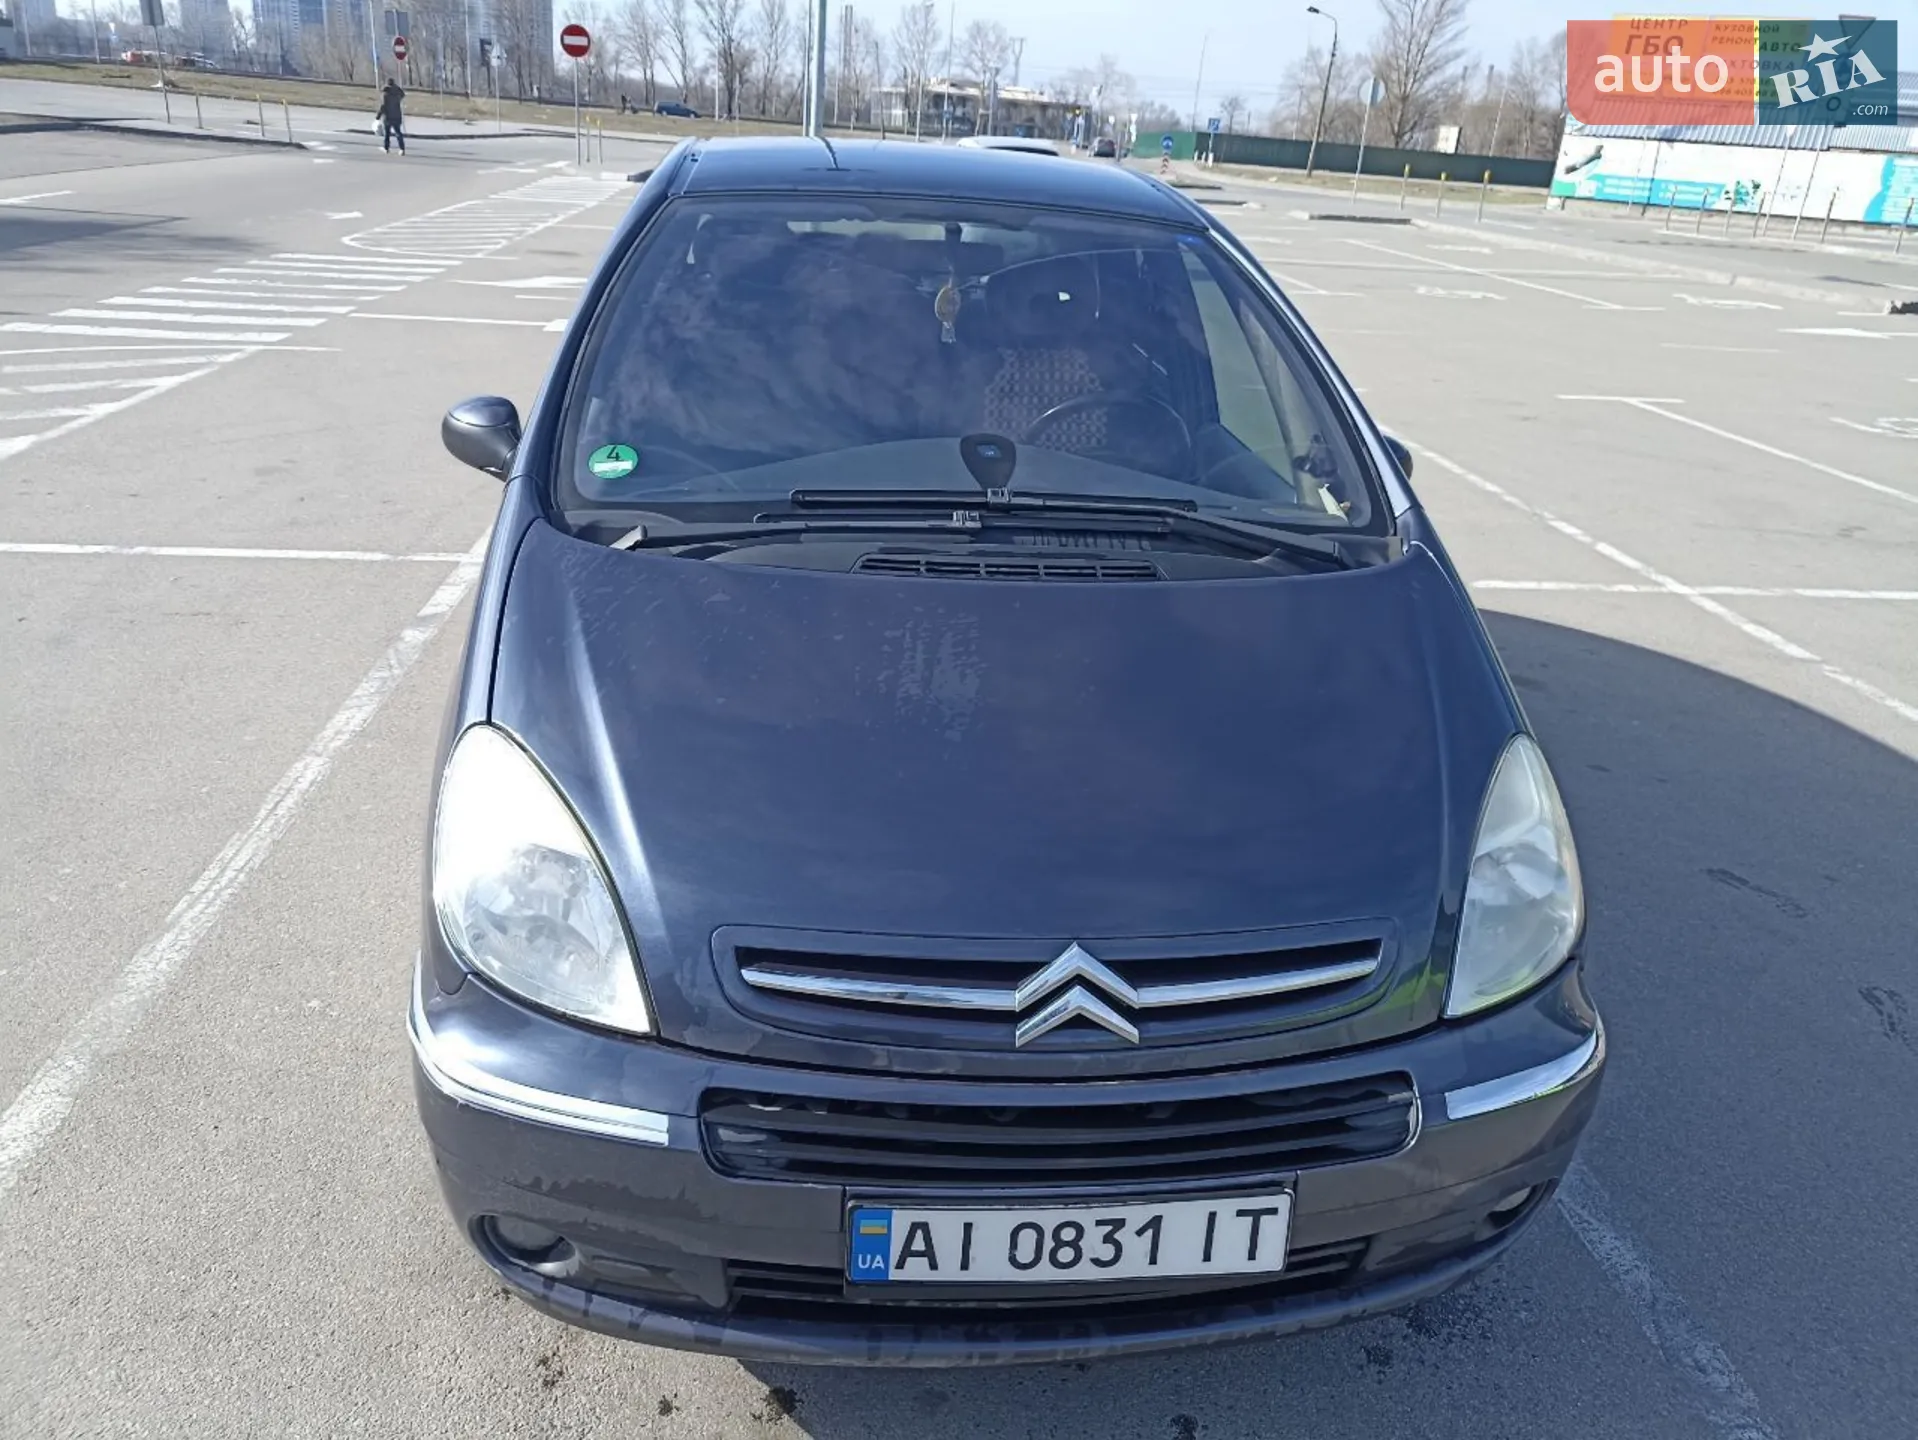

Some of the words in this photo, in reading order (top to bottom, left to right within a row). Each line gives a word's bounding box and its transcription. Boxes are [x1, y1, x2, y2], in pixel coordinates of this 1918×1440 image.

[1630, 18, 1688, 30] ЦЕНТР
[1625, 34, 1684, 55] ГБО
[606, 445, 621, 461] 4
[894, 1221, 973, 1271] AI
[1008, 1214, 1163, 1271] 0831
[1201, 1207, 1279, 1263] IT
[857, 1253, 885, 1269] UA
